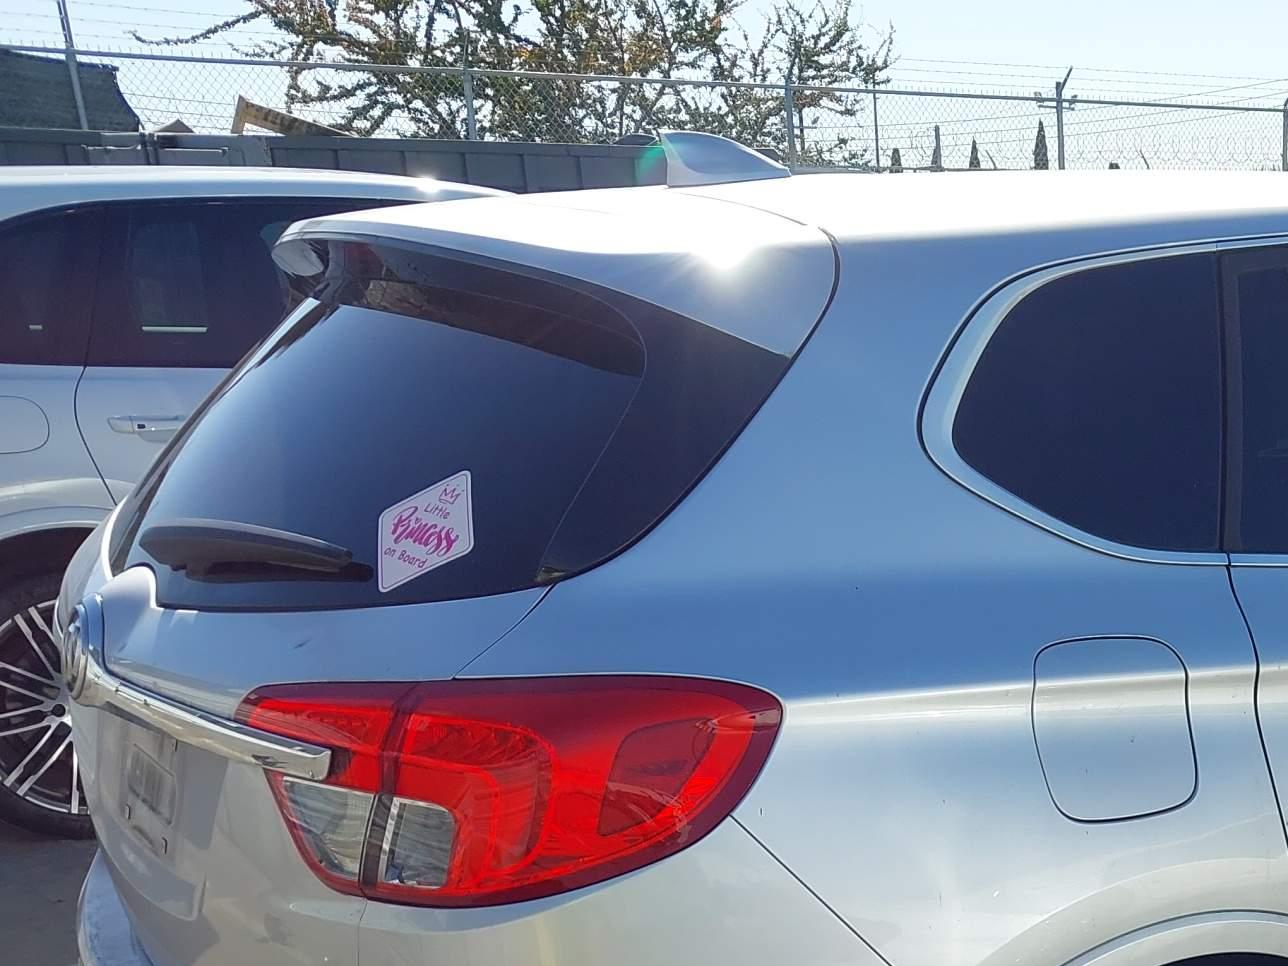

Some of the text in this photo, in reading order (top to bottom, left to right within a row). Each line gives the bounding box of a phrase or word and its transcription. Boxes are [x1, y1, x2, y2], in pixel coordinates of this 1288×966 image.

[424, 503, 450, 519] Little
[391, 506, 459, 557] Princess
[384, 547, 428, 568] on Board
